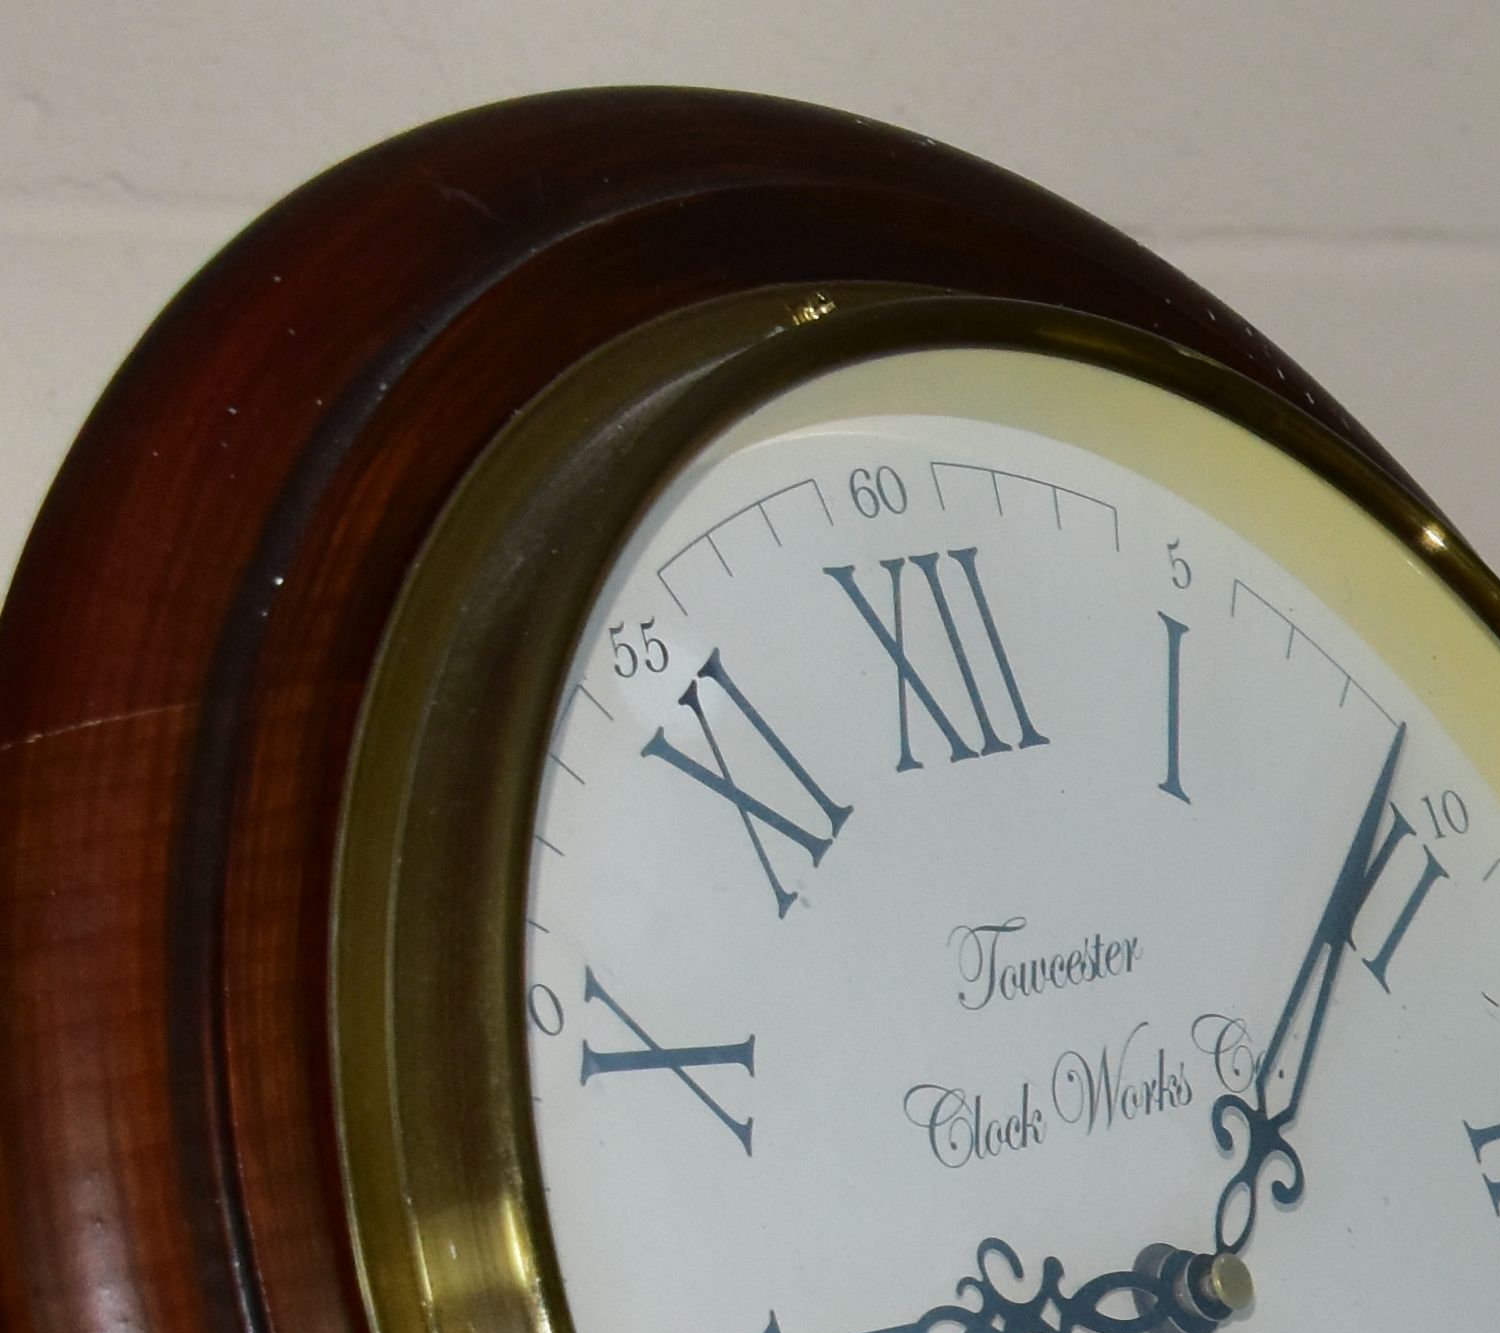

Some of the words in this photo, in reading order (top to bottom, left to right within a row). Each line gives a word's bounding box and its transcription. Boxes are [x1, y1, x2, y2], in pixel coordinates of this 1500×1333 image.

[849, 467, 908, 518] 60
[1167, 539, 1192, 589] 5
[608, 617, 670, 678] 55
[822, 547, 1050, 772] XII
[1157, 610, 1191, 805] I
[641, 647, 854, 919] XI
[1421, 789, 1469, 839] 10
[948, 916, 1143, 1010] Towcester
[580, 965, 755, 1157] X
[904, 1083, 1047, 1168] Clock
